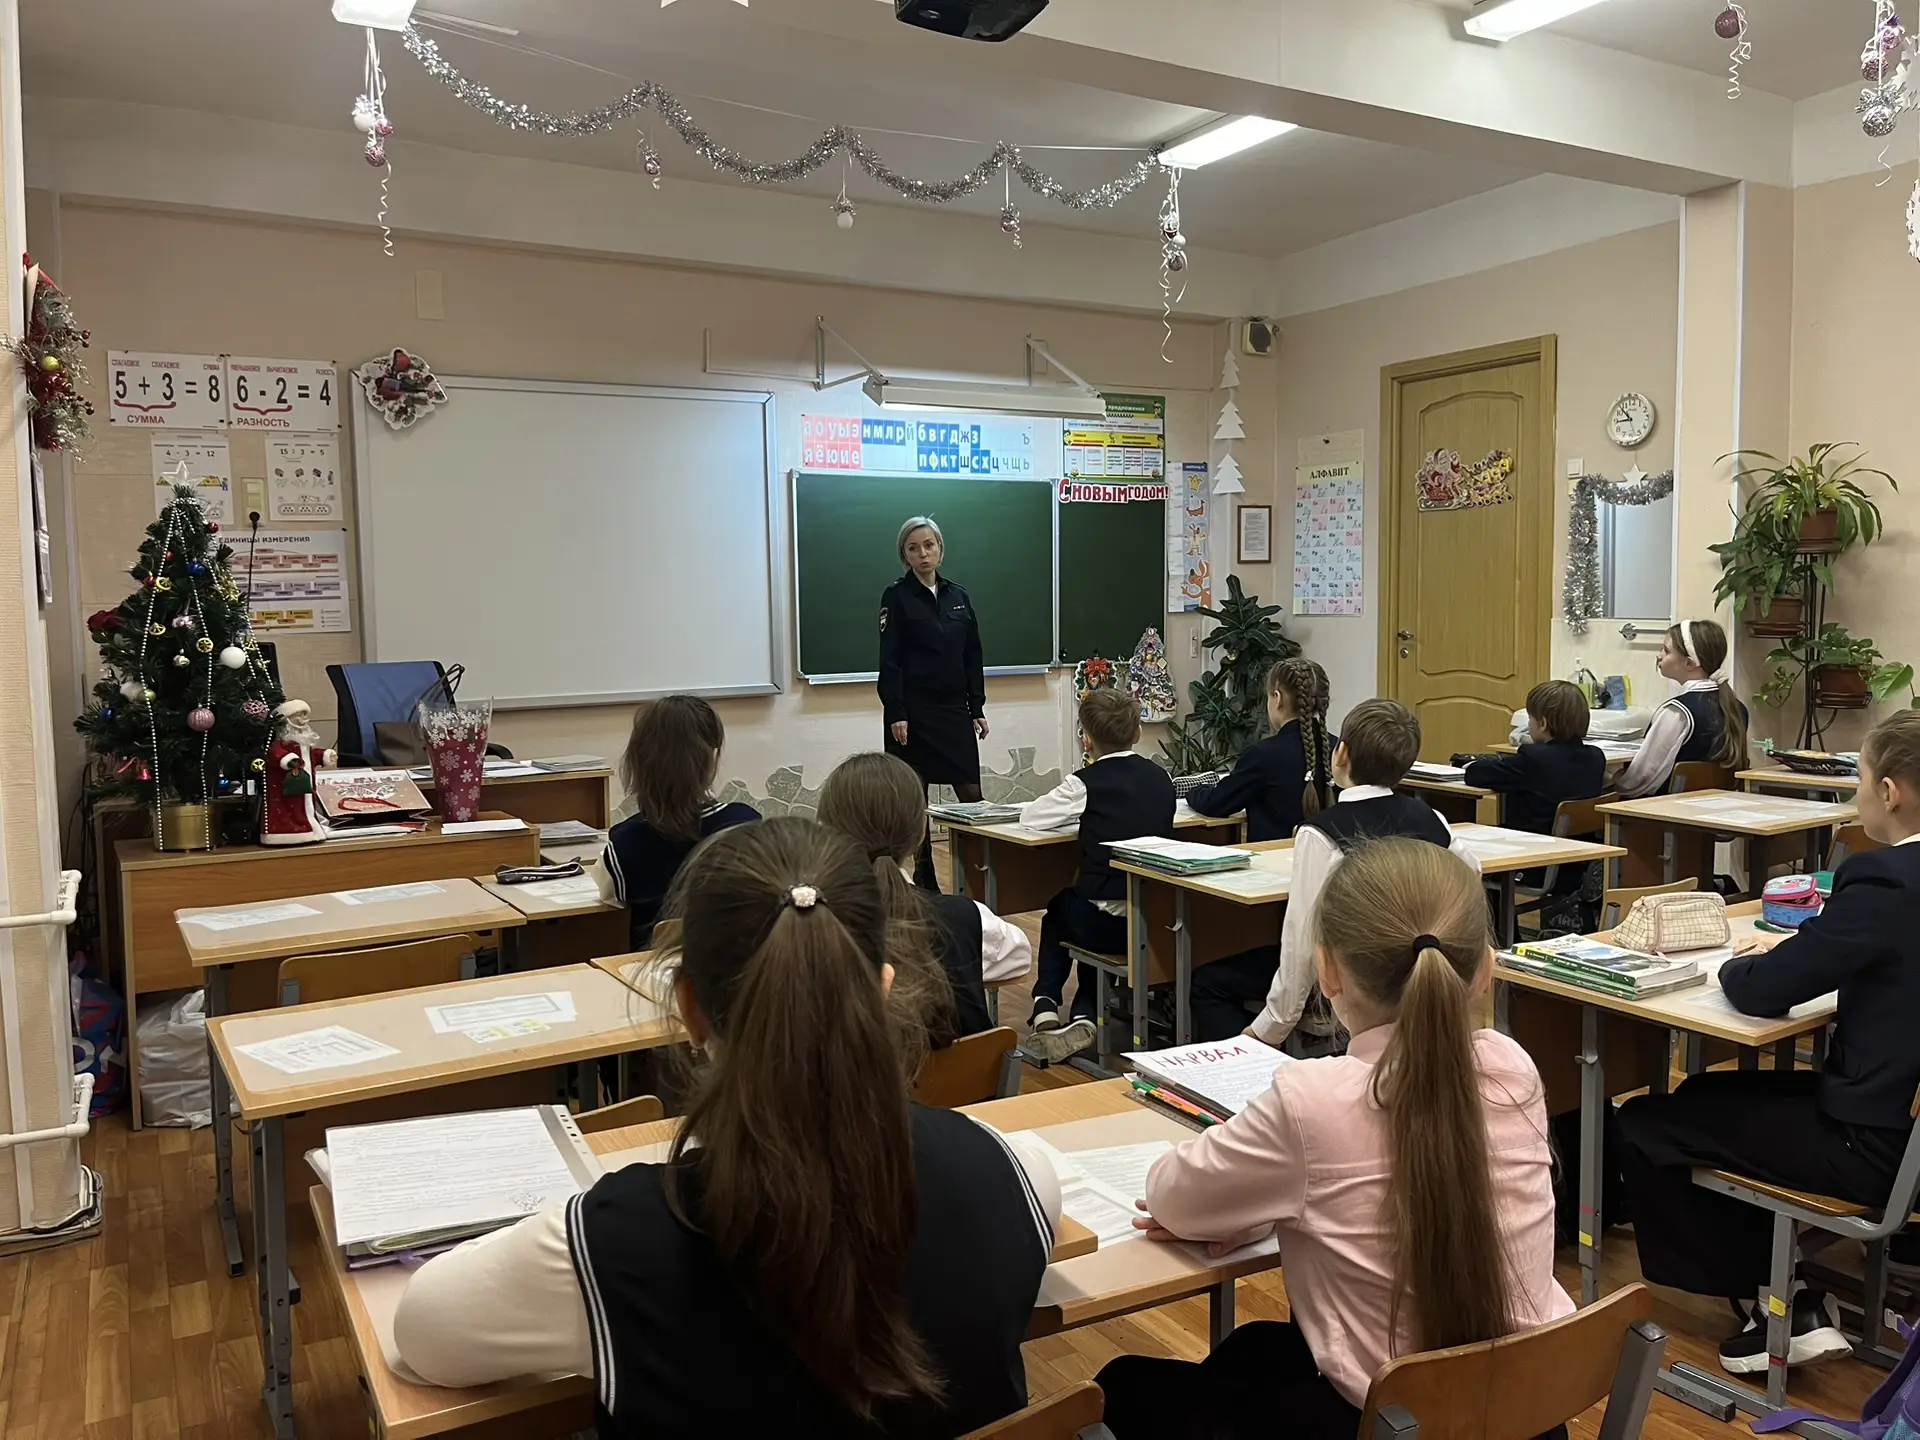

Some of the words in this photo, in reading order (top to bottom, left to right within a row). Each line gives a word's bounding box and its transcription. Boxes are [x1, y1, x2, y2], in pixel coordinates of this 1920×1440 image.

[115, 370, 127, 399] 5
[162, 372, 174, 401] 3
[208, 374, 220, 402] 8
[236, 375, 248, 403] 6
[276, 377, 288, 404] 2
[320, 379, 331, 406] 4
[126, 414, 165, 424] СУММА
[237, 417, 290, 428] РАЗНОСТЬ
[165, 449, 171, 457] 4
[206, 450, 216, 458] 12
[279, 448, 289, 456] 15
[1309, 466, 1350, 480] АЛФАВИТ
[1072, 484, 1129, 502] НОВЫМ
[262, 536, 311, 544] ИЗМЕРЕНИЯ
[1152, 1045, 1249, 1069] НАРВАЛ
